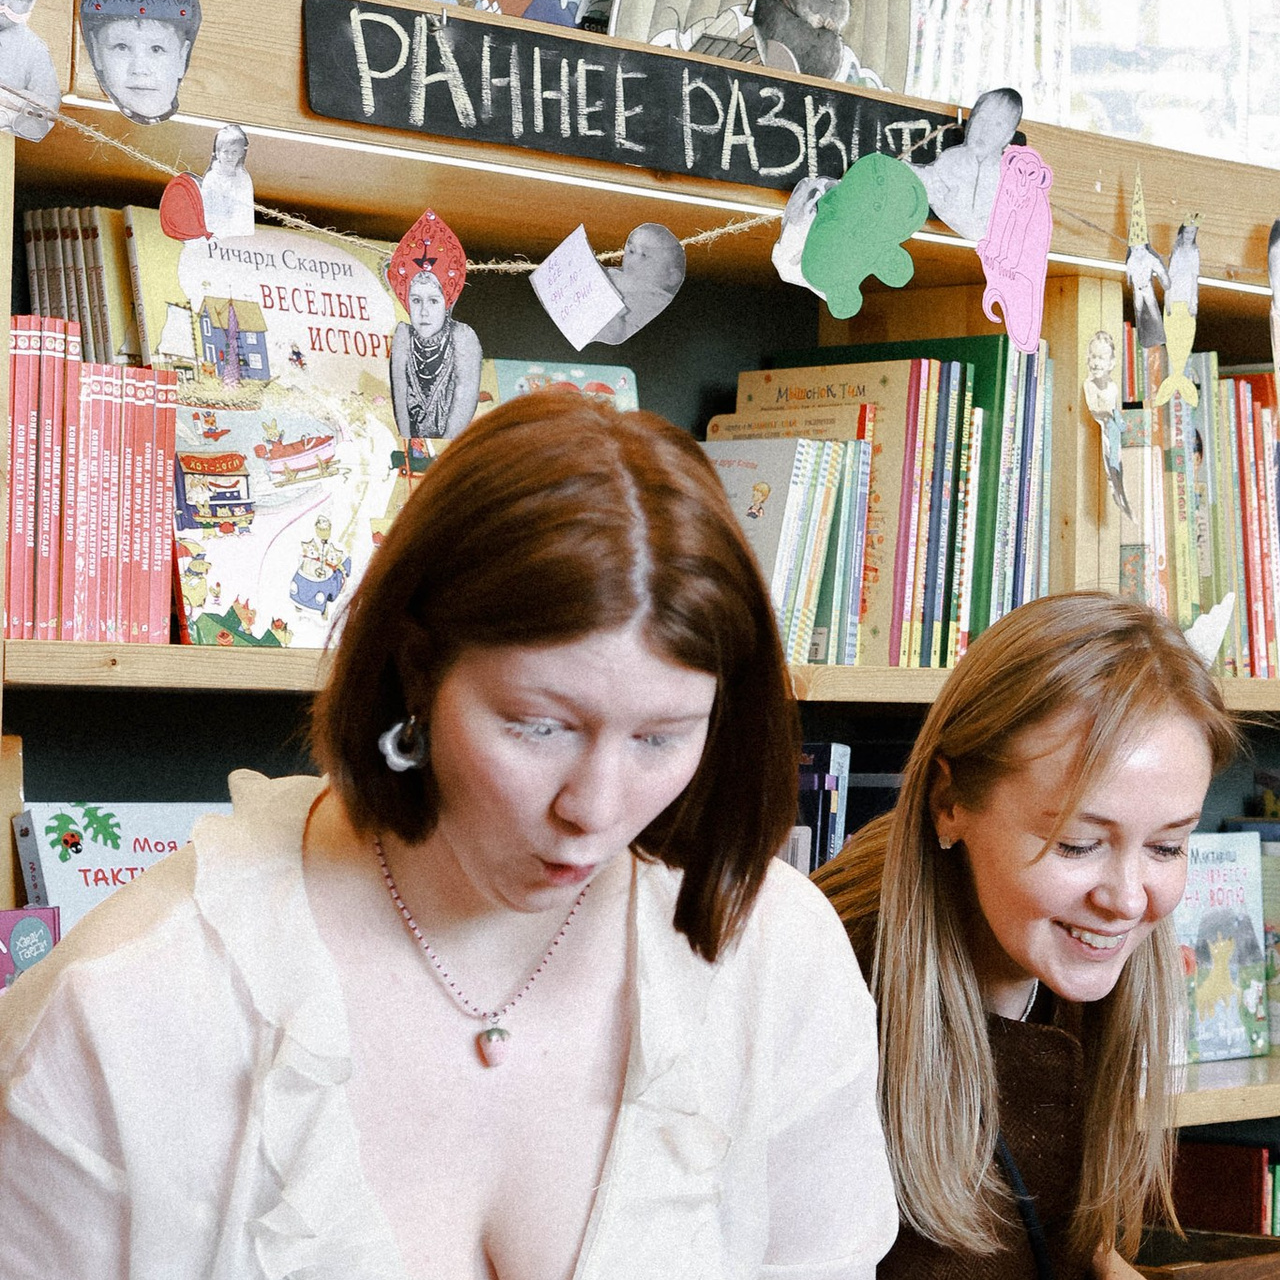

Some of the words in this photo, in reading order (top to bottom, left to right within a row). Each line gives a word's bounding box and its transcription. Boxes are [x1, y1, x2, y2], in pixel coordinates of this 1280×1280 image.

[350, 5, 648, 152] РАННЕЕ
[681, 65, 942, 179] РАЗВИТ
[207, 242, 276, 269] Ричард
[282, 249, 353, 280] Скарри
[260, 283, 370, 321] ВЕСЁЛЫЕ
[308, 326, 392, 359] ИСТОРИ
[948, 390, 958, 443] МЫШОНОК
[962, 392, 972, 444] МЫШОНОК
[17, 425, 25, 453] КОННИ
[68, 426, 76, 454] КОННИ
[16, 458, 24, 480] ЕДЕТ
[28, 444, 36, 502] ЗАНИМАЕТСЯ
[90, 460, 98, 483] ИДЁТ
[156, 449, 164, 477] КОННИ
[945, 448, 953, 470] ТИМ
[960, 449, 968, 471] ТИМ
[16, 484, 24, 495] НА
[52, 488, 60, 516] МУСОР
[67, 466, 75, 506] КЕМПИНГ
[111, 486, 118, 497] НА
[143, 473, 151, 528] ЗАНИМАЕТСЯ
[15, 499, 24, 533] ПИКНИК
[42, 490, 50, 531] ДЕТСКОМ
[123, 478, 131, 531] ПОБЕЖДАЕТ
[134, 513, 141, 524] НА
[155, 512, 162, 523] НА
[164, 491, 172, 535] ПОМОГАЕТ
[27, 505, 35, 547] МУЗЫКОЙ
[89, 495, 97, 577] ПАРИКМАХЕРСКУЮ
[110, 500, 118, 557] БОЛЬНИЧНОМ
[956, 509, 964, 548] ГОВОРИТ
[41, 534, 49, 557] САДУ
[133, 527, 141, 561] ГОРШОК
[154, 526, 162, 571] САМОЛЁТЕ
[133, 838, 178, 853] Моя
